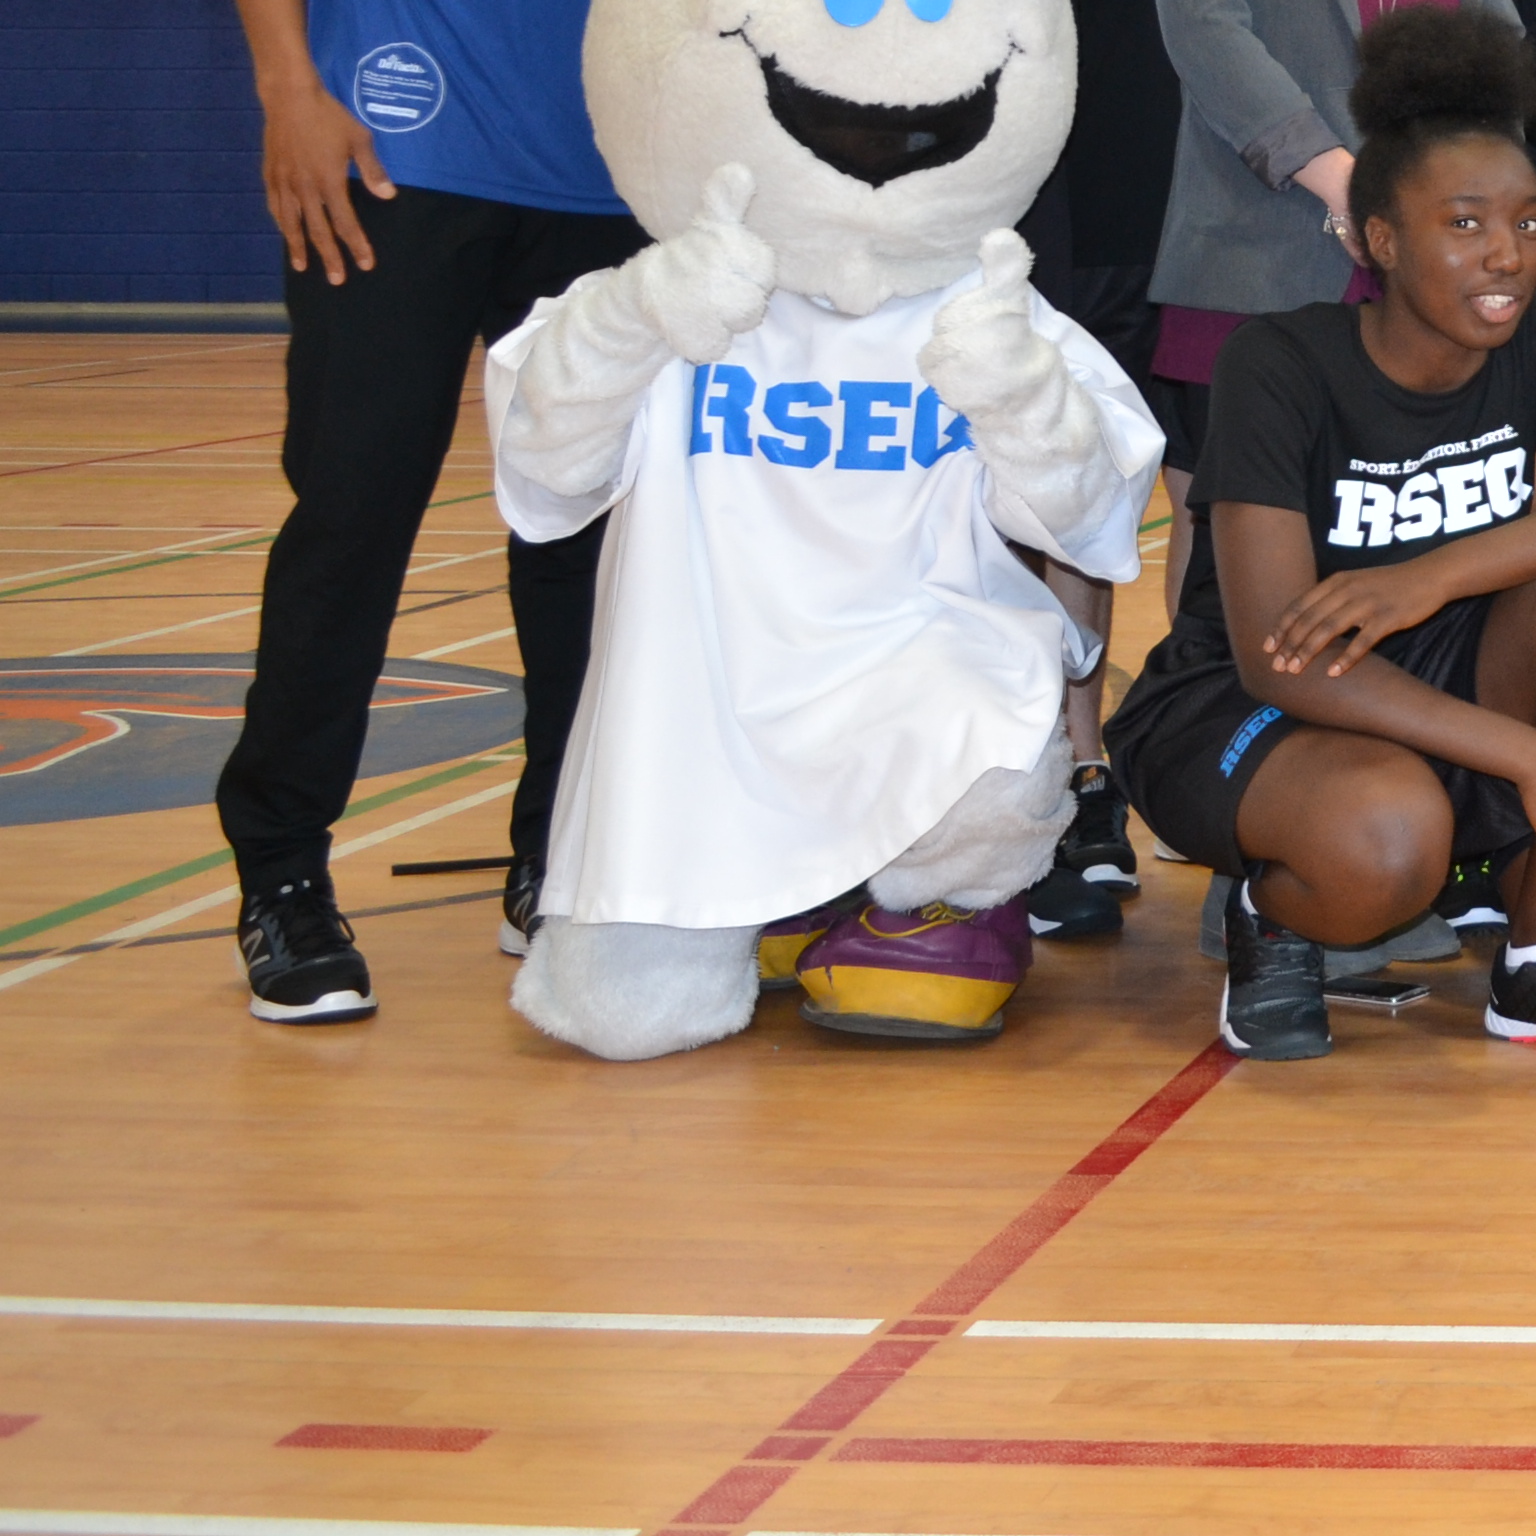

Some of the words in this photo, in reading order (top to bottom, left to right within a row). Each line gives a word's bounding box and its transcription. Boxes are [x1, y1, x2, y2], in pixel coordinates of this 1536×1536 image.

[689, 363, 977, 472] RSEQ
[1350, 459, 1401, 475] SPORT.
[1402, 441, 1470, 474] ÉDATION.
[1327, 447, 1533, 547] RSEQ
[1220, 707, 1283, 778] RSEQ
